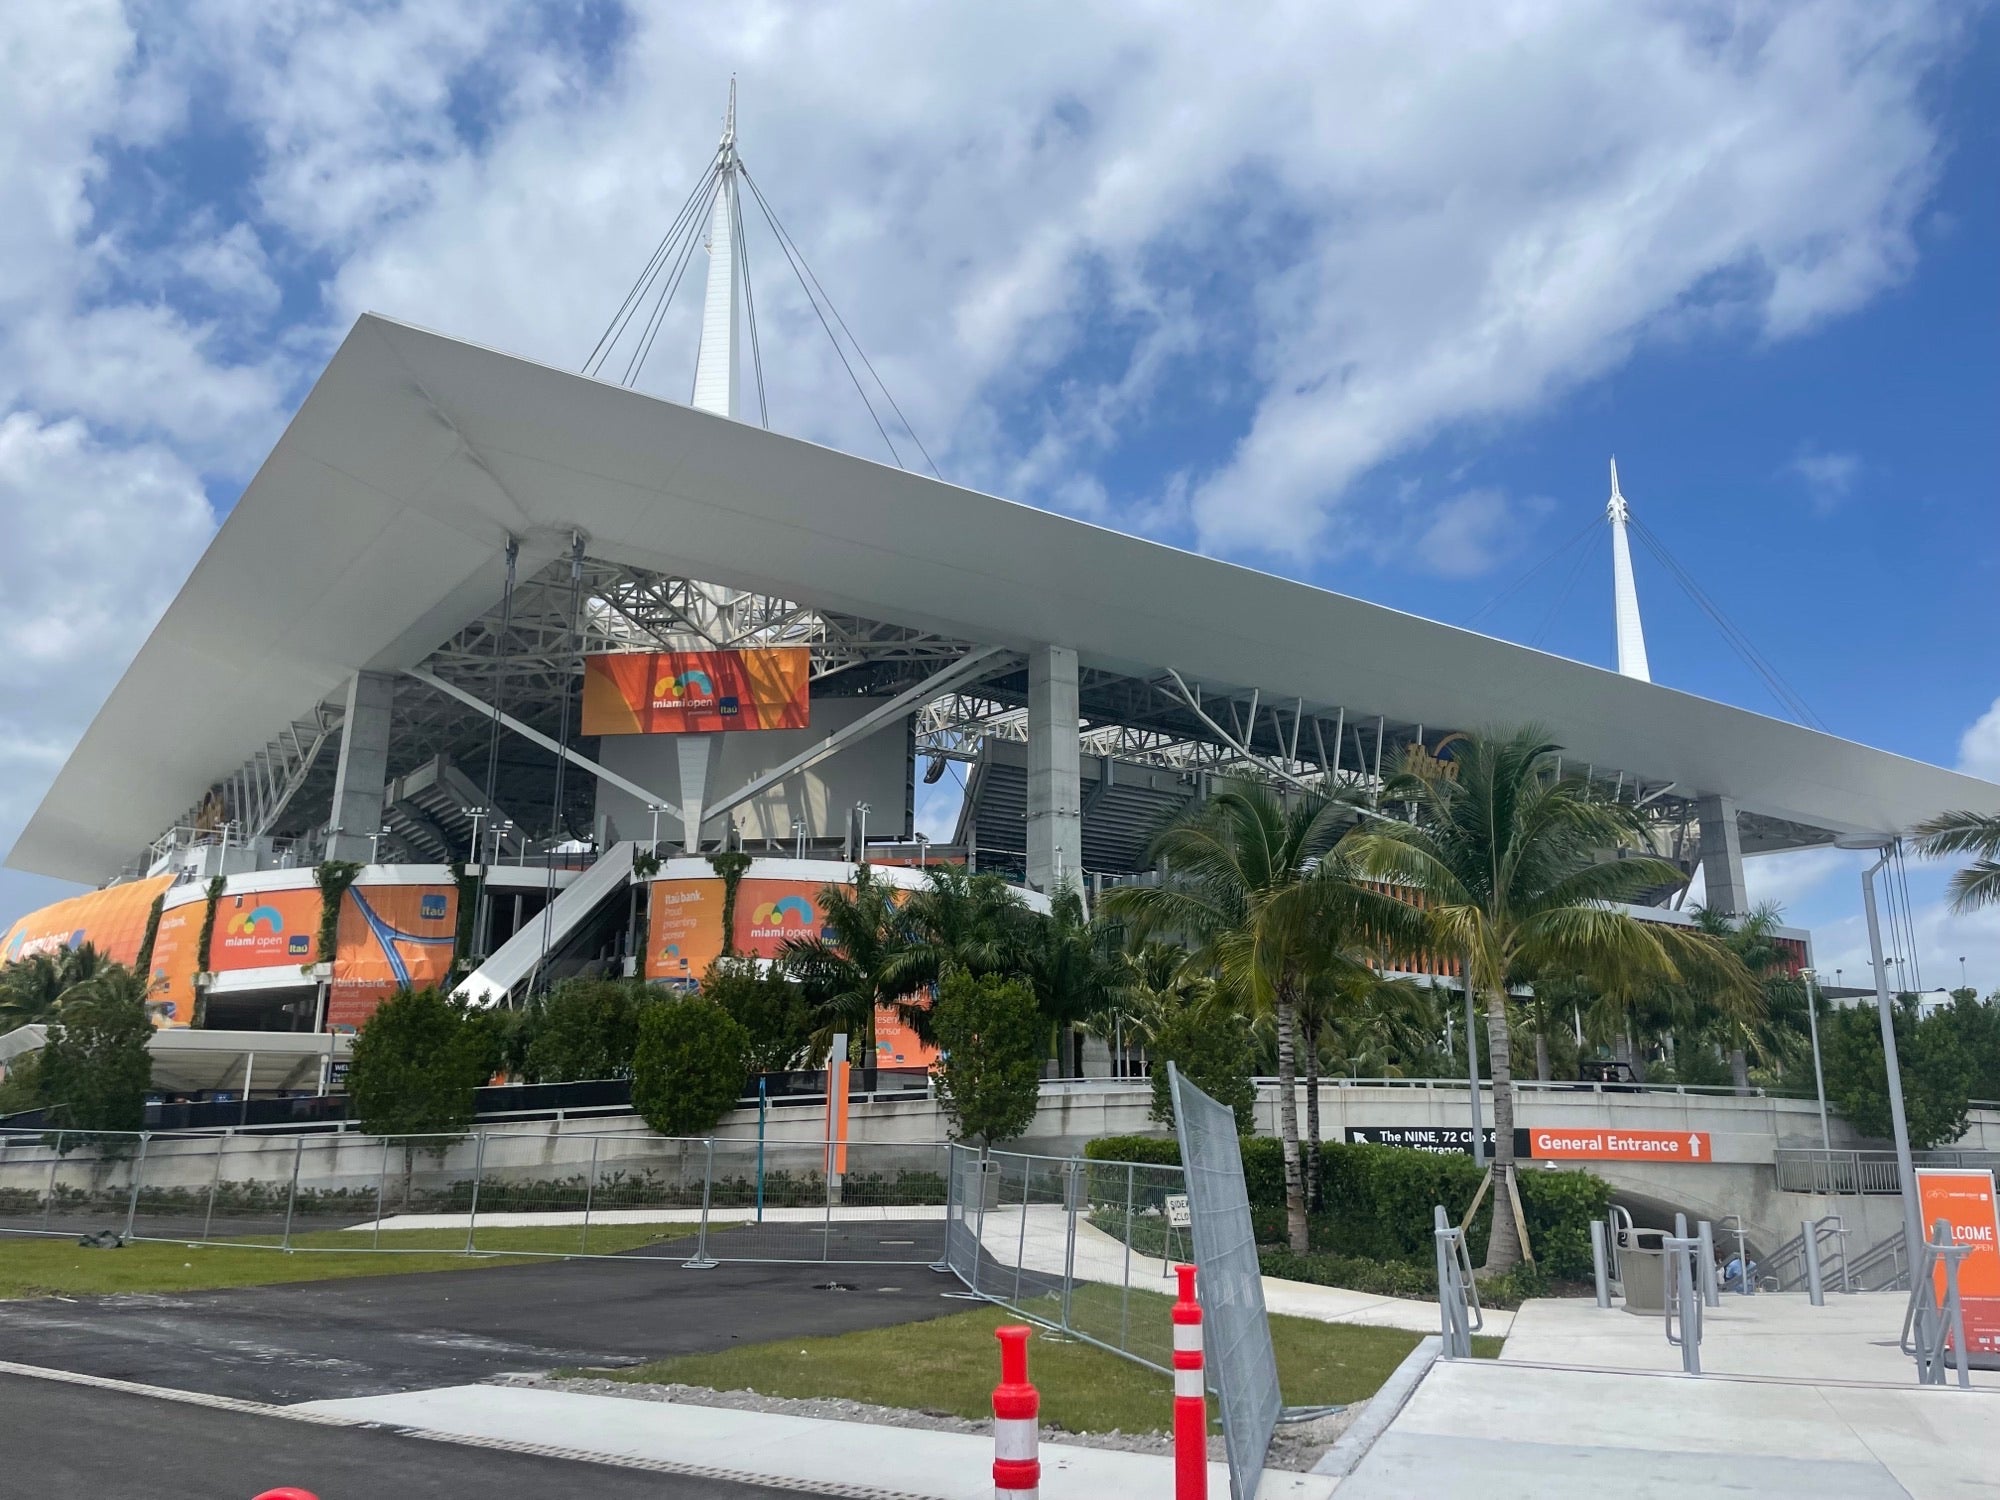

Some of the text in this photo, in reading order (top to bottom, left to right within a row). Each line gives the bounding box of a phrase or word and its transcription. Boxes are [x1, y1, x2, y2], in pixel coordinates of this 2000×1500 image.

[653, 699, 713, 710] miami open
[720, 706, 737, 714] Itaú
[751, 927, 813, 939] miami open
[225, 936, 282, 948] miami open
[289, 944, 307, 953] Itaú
[1380, 1131, 1401, 1142] The
[1405, 1132, 1439, 1144] NINE,
[1442, 1132, 1457, 1143] 72
[1461, 1132, 1487, 1143] Cl
[1538, 1134, 1679, 1152] General Entrance
[1929, 1225, 1993, 1241] LCOME
